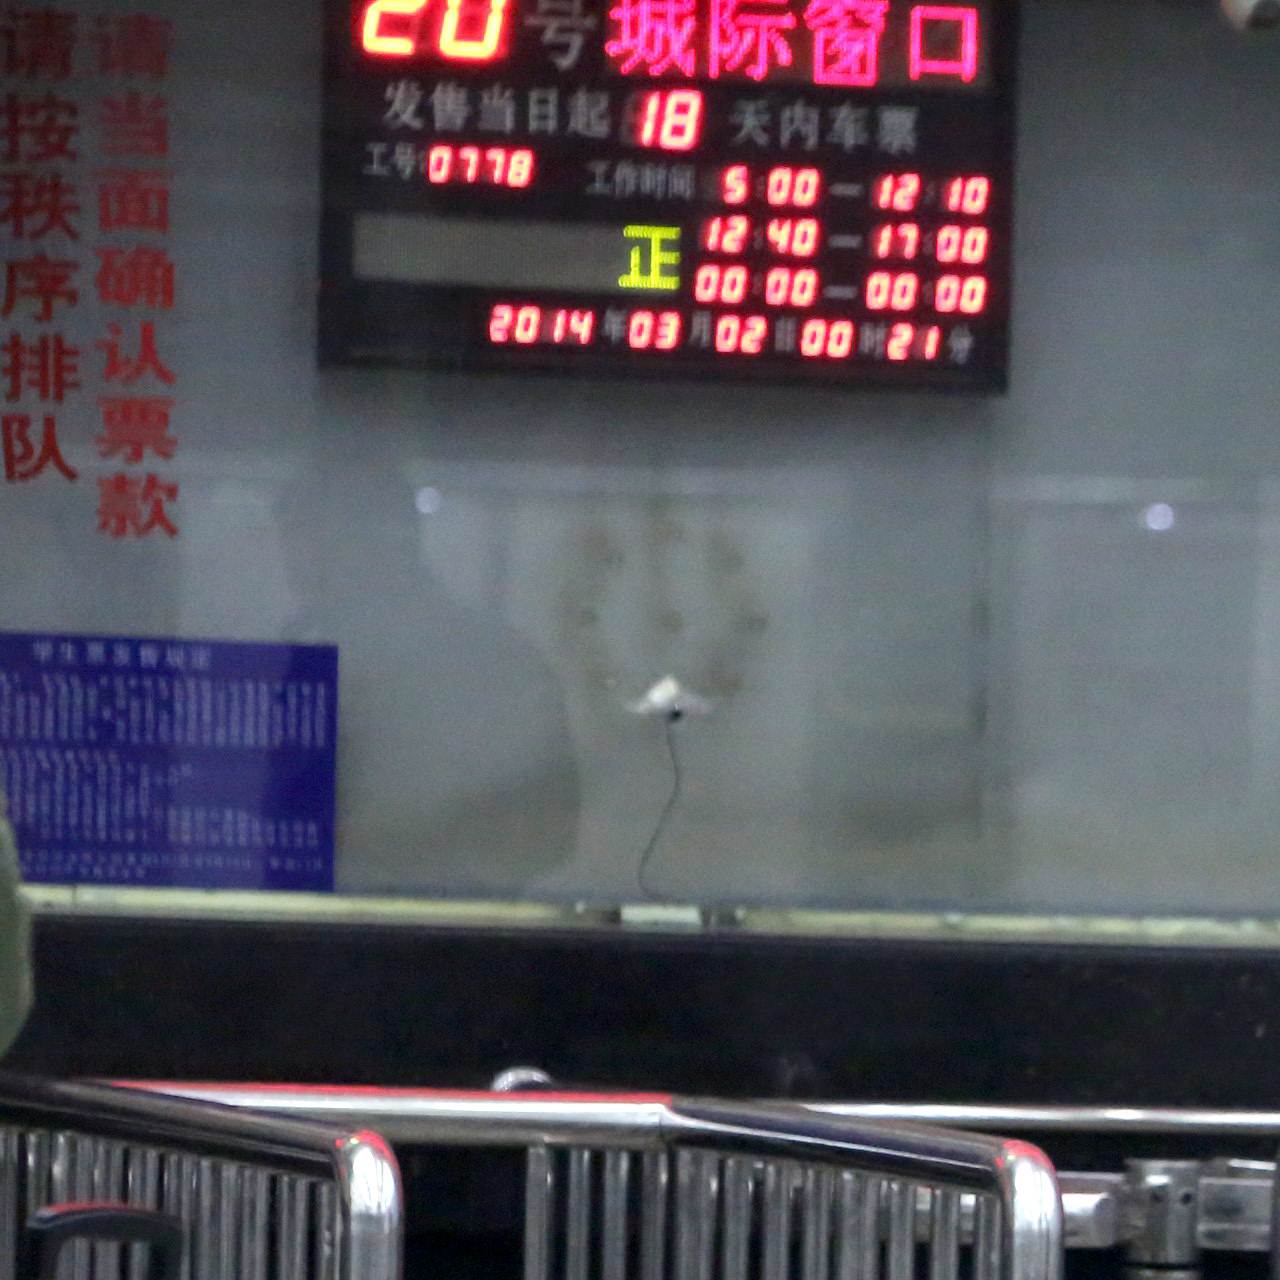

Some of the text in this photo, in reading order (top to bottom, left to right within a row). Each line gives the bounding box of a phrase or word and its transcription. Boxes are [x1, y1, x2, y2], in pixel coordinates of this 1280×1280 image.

[605, 0, 979, 89] 城际窗口
[637, 87, 704, 151] 18
[427, 144, 535, 188] 0778
[618, 225, 681, 289] 正
[489, 304, 595, 344] 2014
